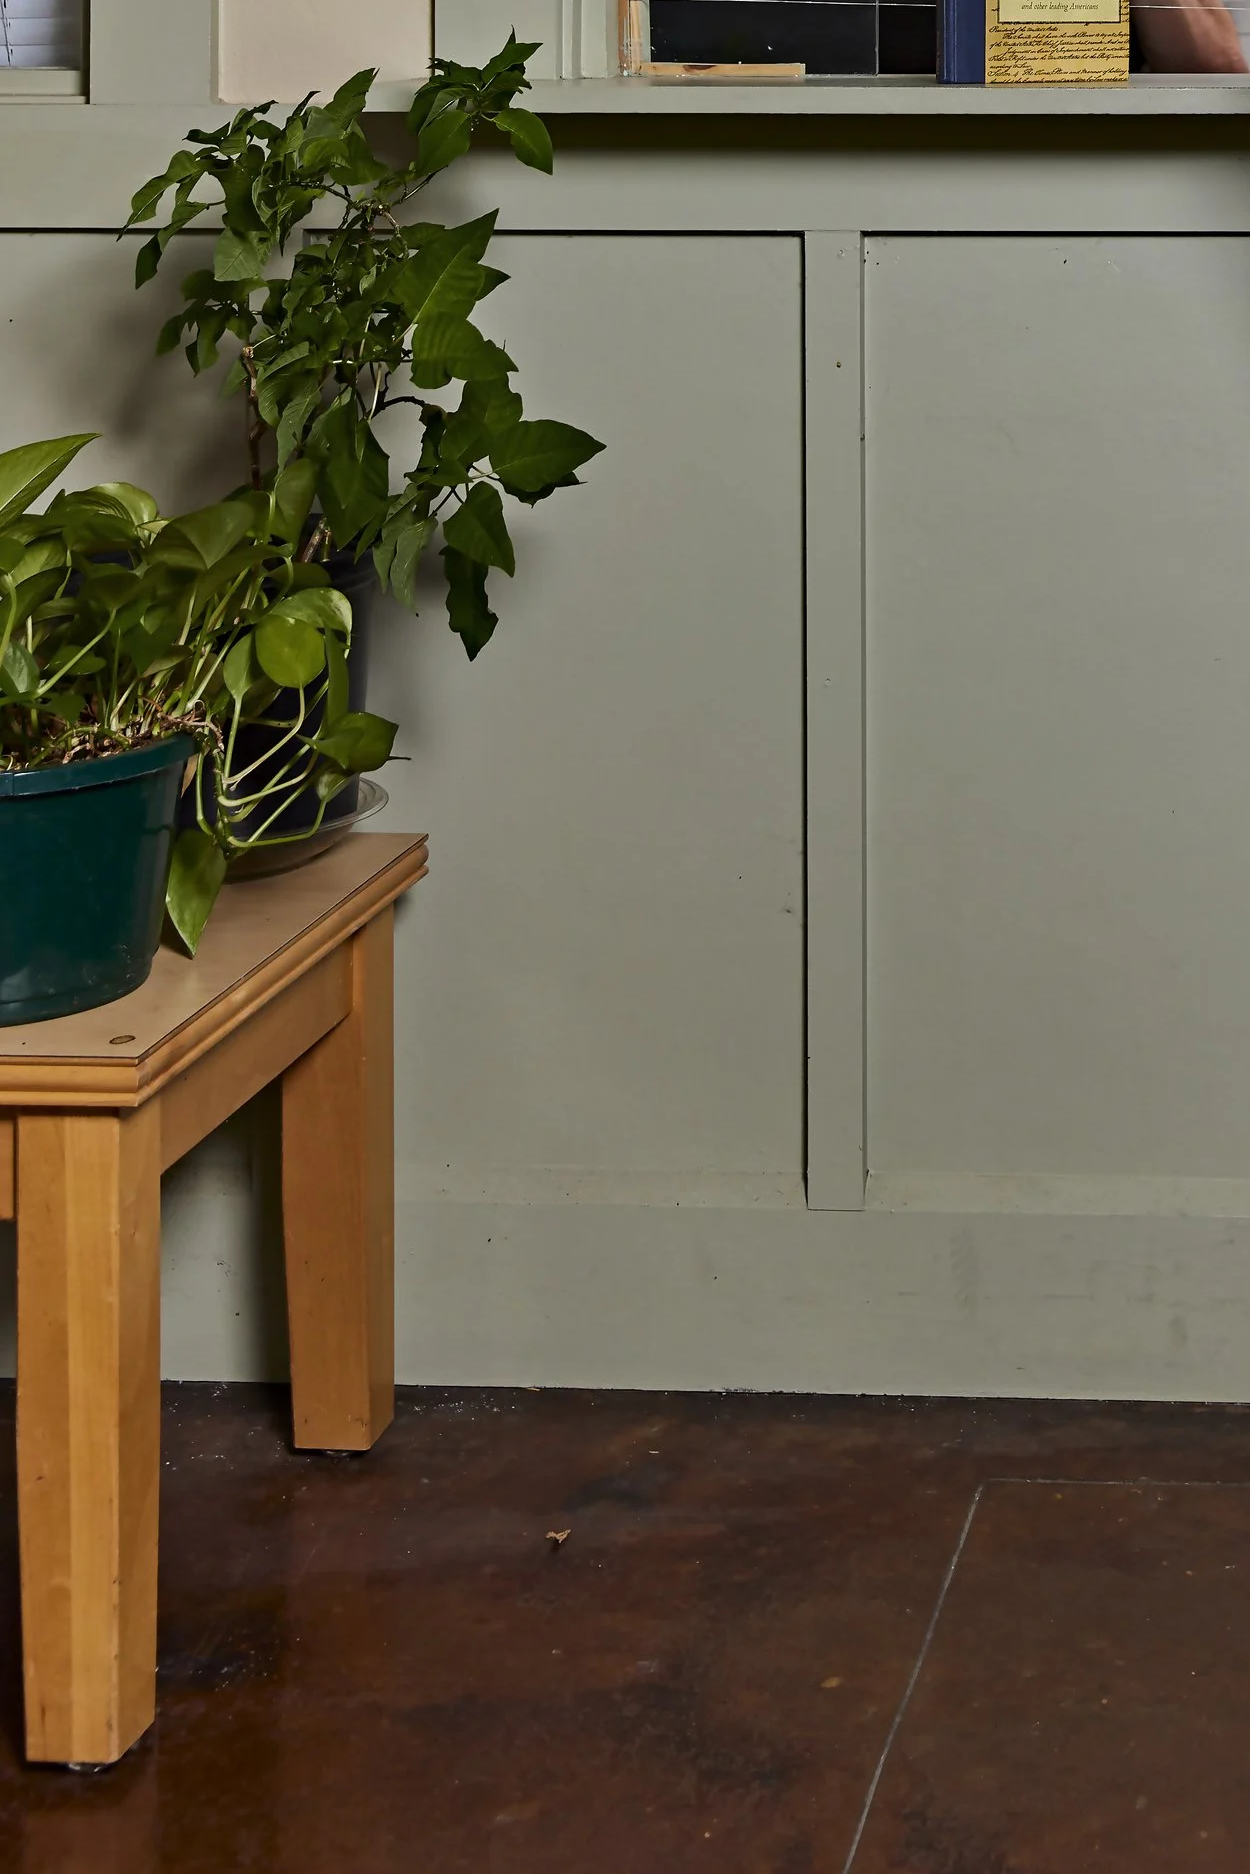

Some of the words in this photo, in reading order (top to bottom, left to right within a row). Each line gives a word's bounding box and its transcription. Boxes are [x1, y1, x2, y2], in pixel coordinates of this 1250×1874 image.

[1021, 2, 1033, 10] and
[1033, 2, 1048, 10] other
[1049, 2, 1068, 13] leading
[1069, 2, 1099, 10] Americans
